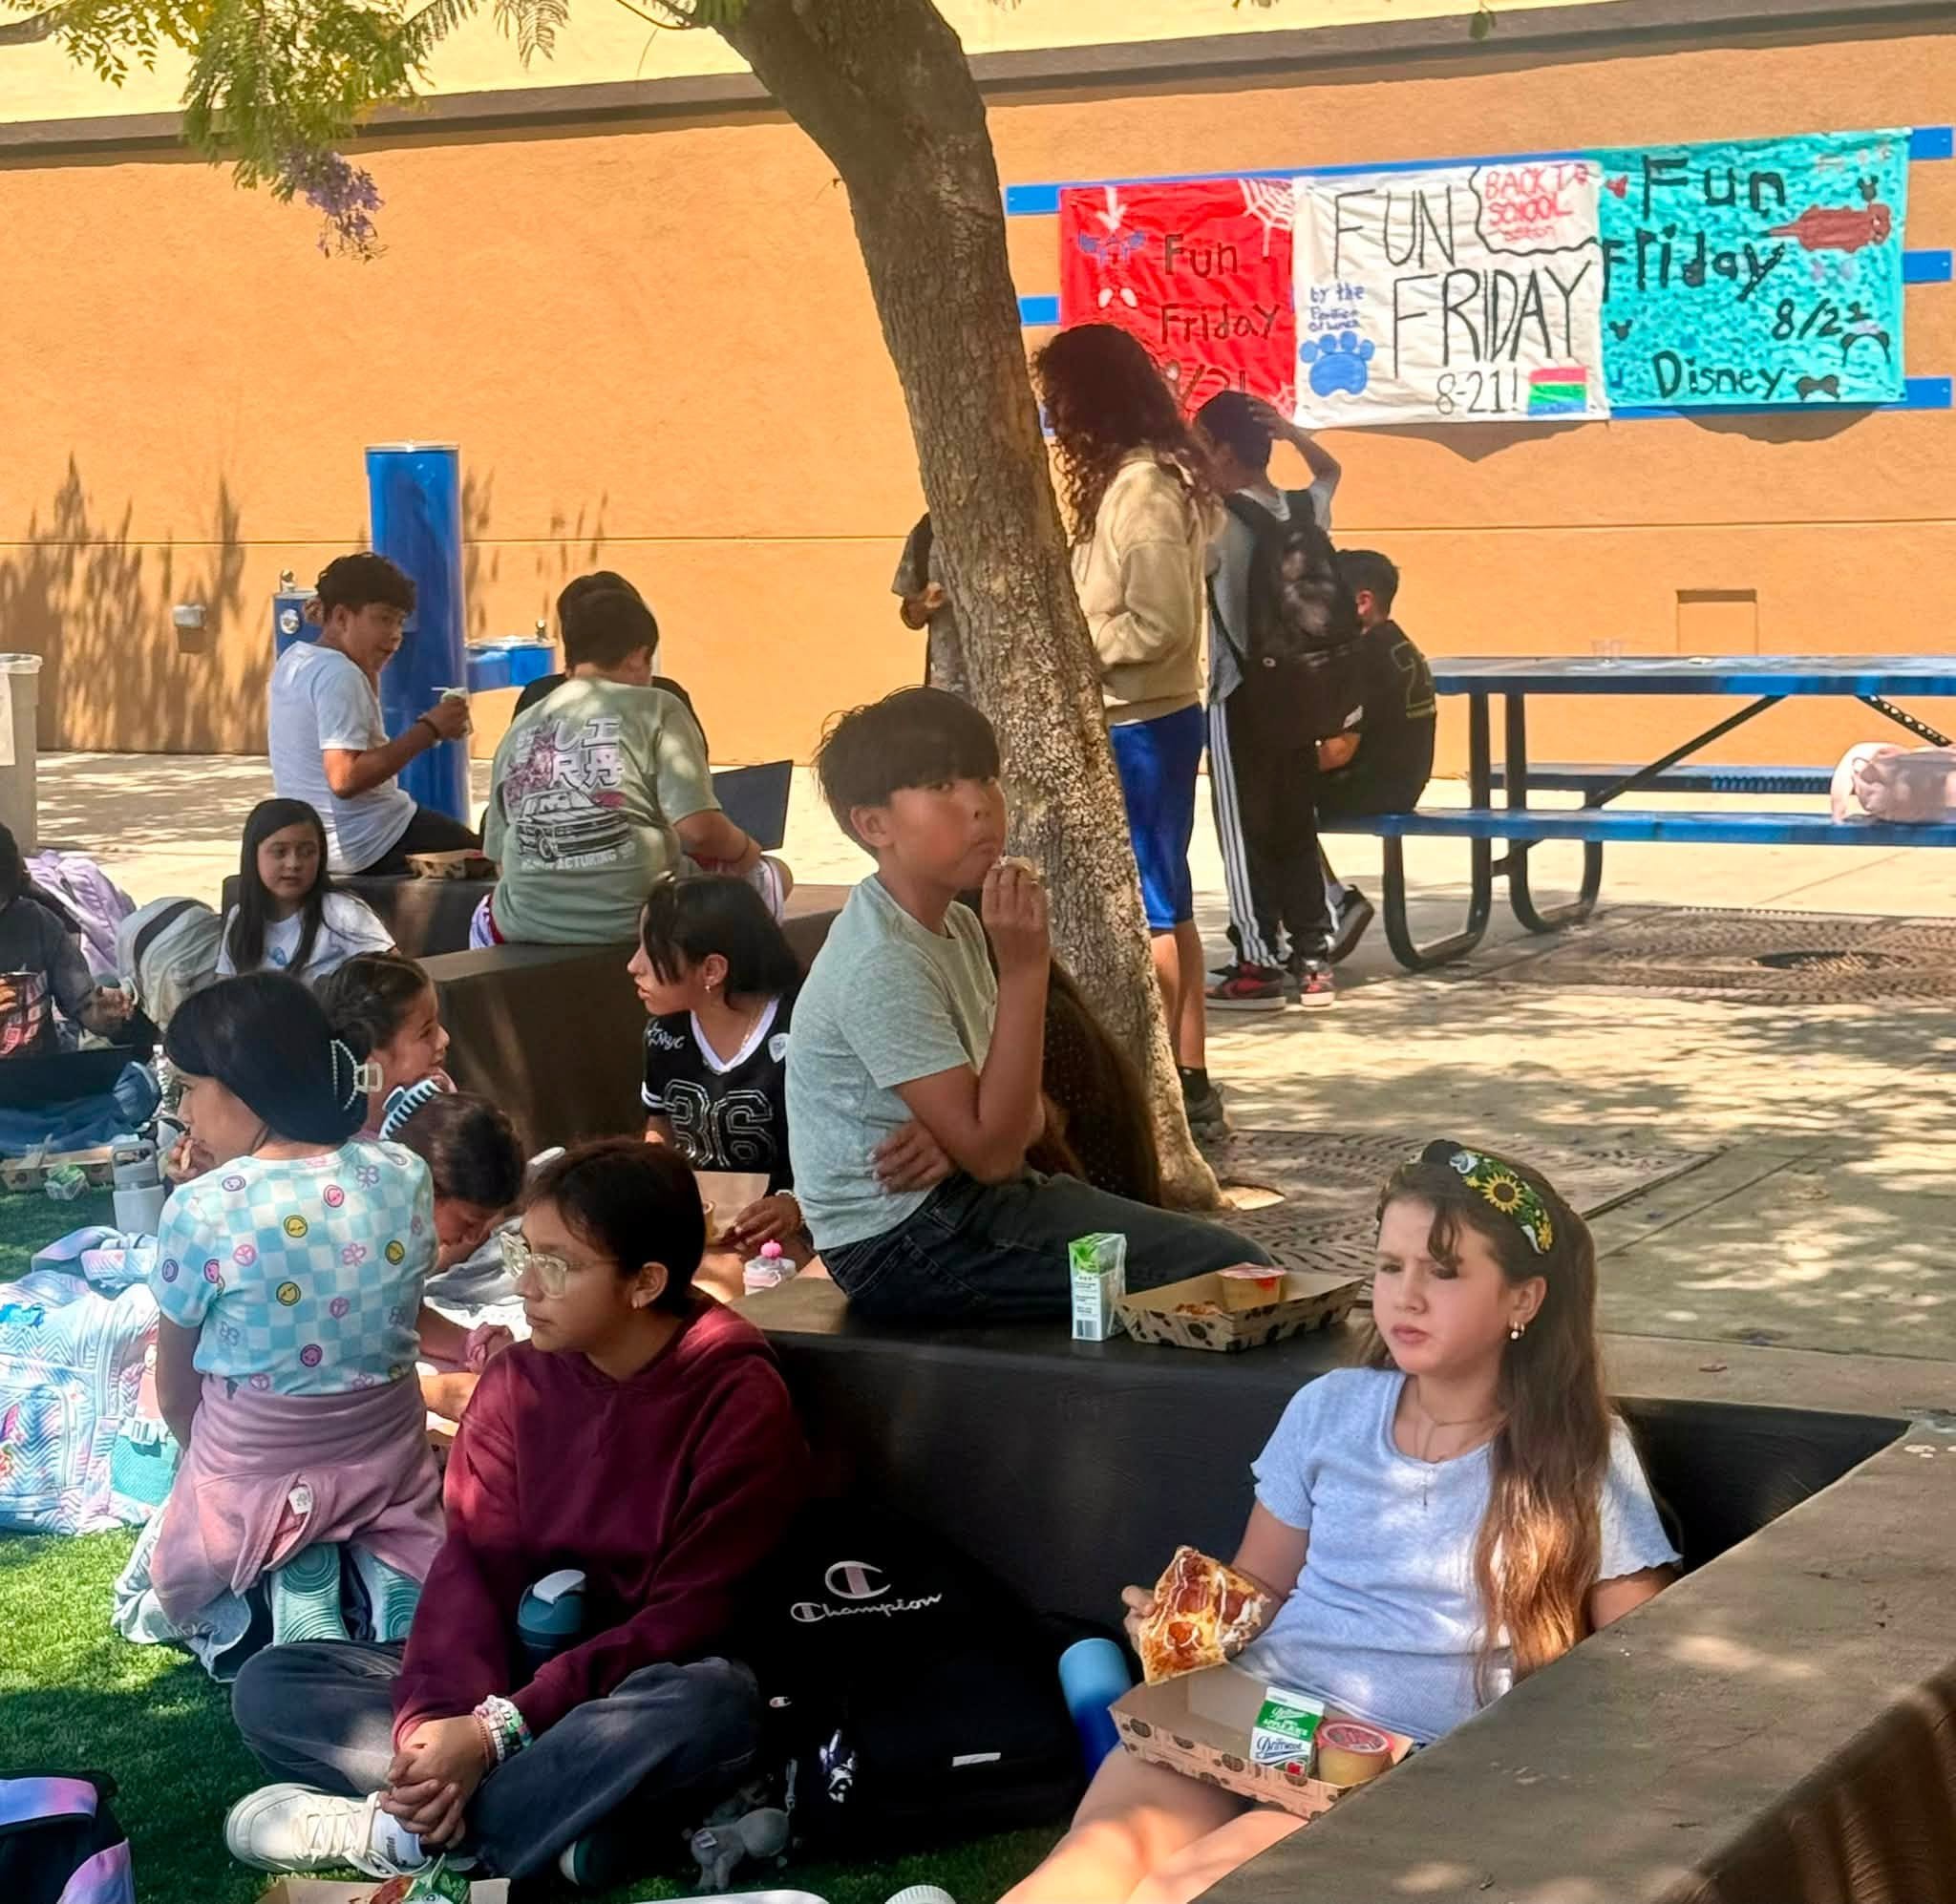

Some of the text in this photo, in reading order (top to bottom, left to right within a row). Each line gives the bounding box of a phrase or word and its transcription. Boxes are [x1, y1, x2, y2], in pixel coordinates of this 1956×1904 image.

[1486, 168, 1545, 200] BACK
[1642, 154, 1786, 222] Fun
[1333, 185, 1456, 280] FUN
[1489, 193, 1573, 225] SCHOOL
[1165, 234, 1238, 278] Fun
[1603, 223, 1786, 304] Friday
[1393, 260, 1592, 379] FRIDAY
[1435, 368, 1519, 414] 8-21!
[1652, 350, 1786, 400] Disney
[790, 1593, 943, 1622] Champion
